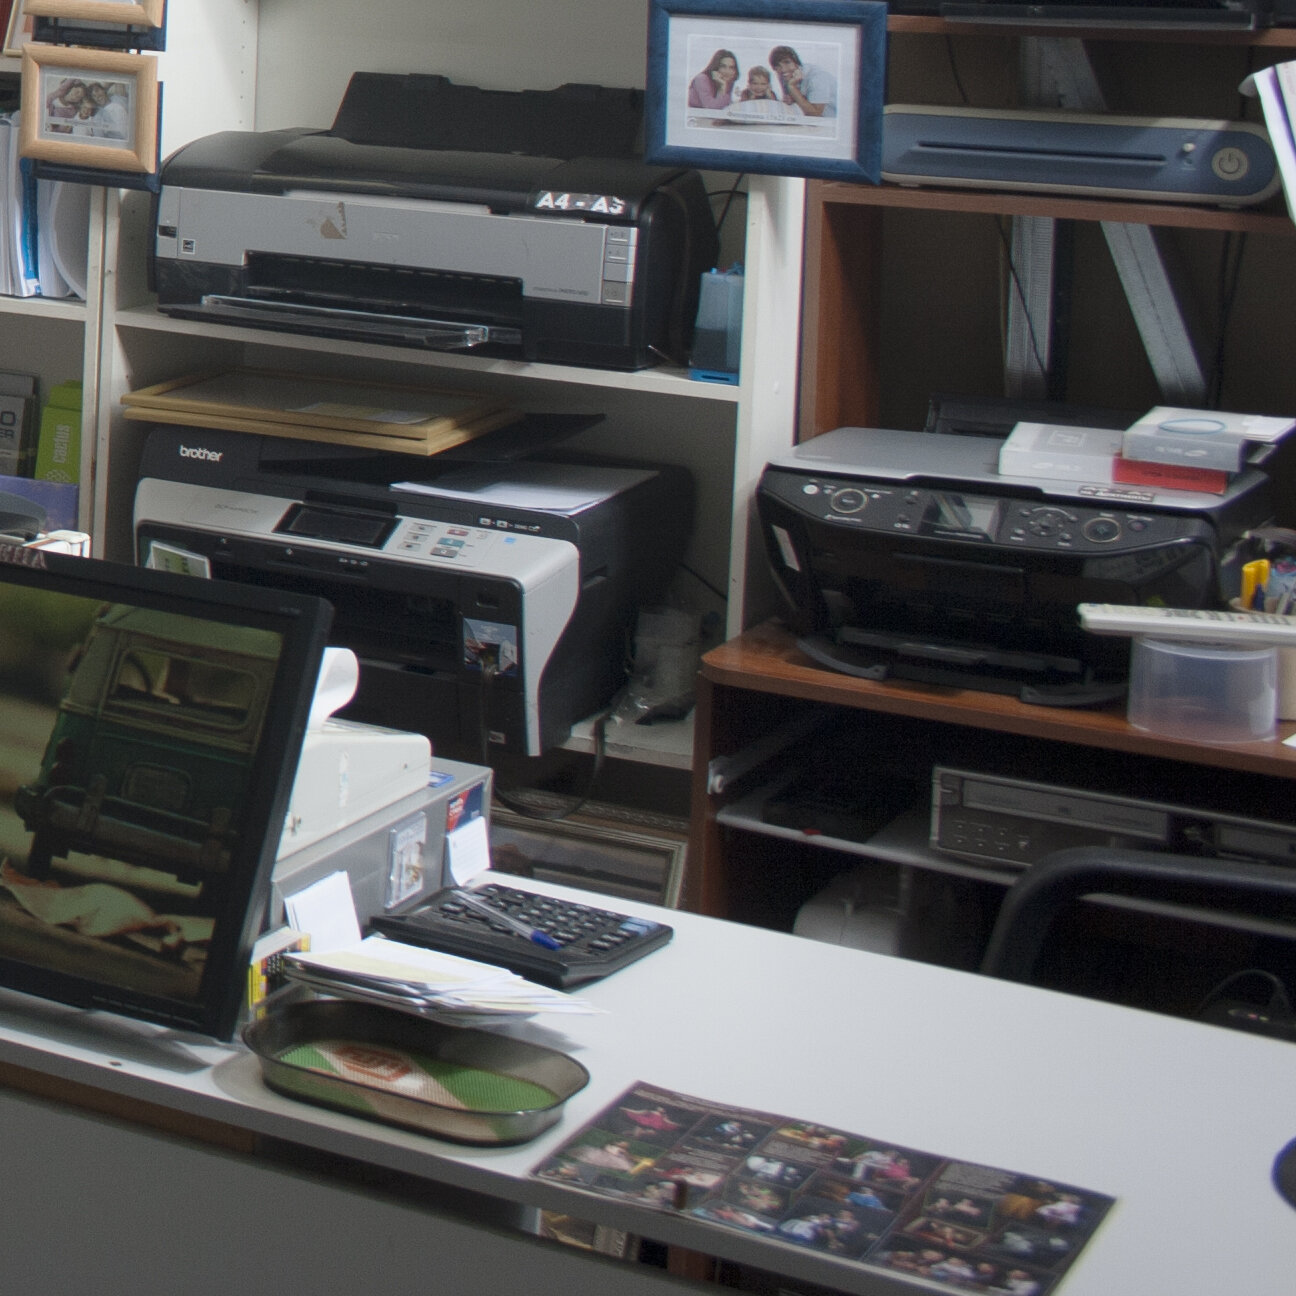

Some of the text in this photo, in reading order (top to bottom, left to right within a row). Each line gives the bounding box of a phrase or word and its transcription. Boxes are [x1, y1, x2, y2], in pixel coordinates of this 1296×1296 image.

[535, 192, 570, 209] A4
[53, 424, 72, 464] cactus
[179, 445, 223, 462] brother
